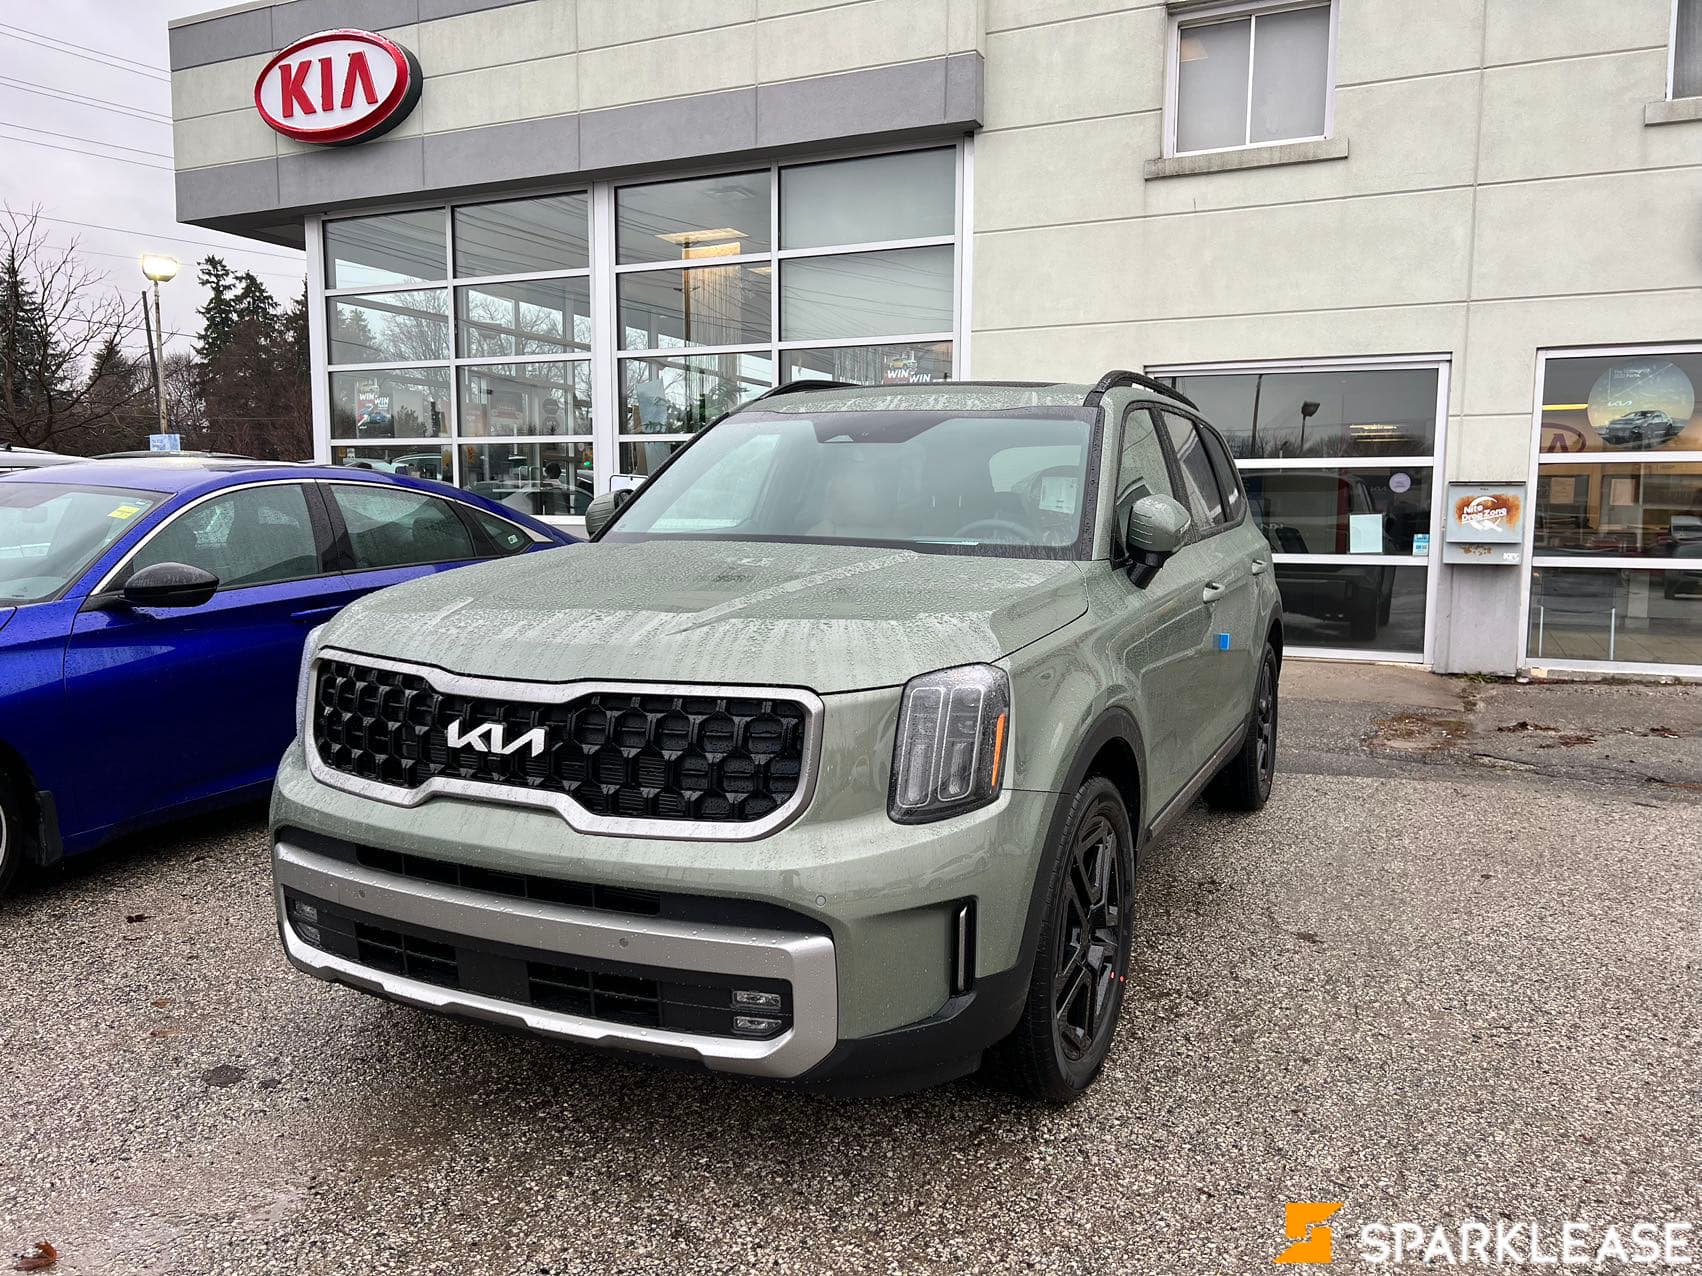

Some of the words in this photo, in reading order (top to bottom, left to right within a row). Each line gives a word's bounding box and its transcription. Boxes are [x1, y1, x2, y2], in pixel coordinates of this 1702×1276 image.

[278, 50, 379, 118] KIA
[887, 369, 909, 378] WIN
[909, 374, 931, 383] WIN
